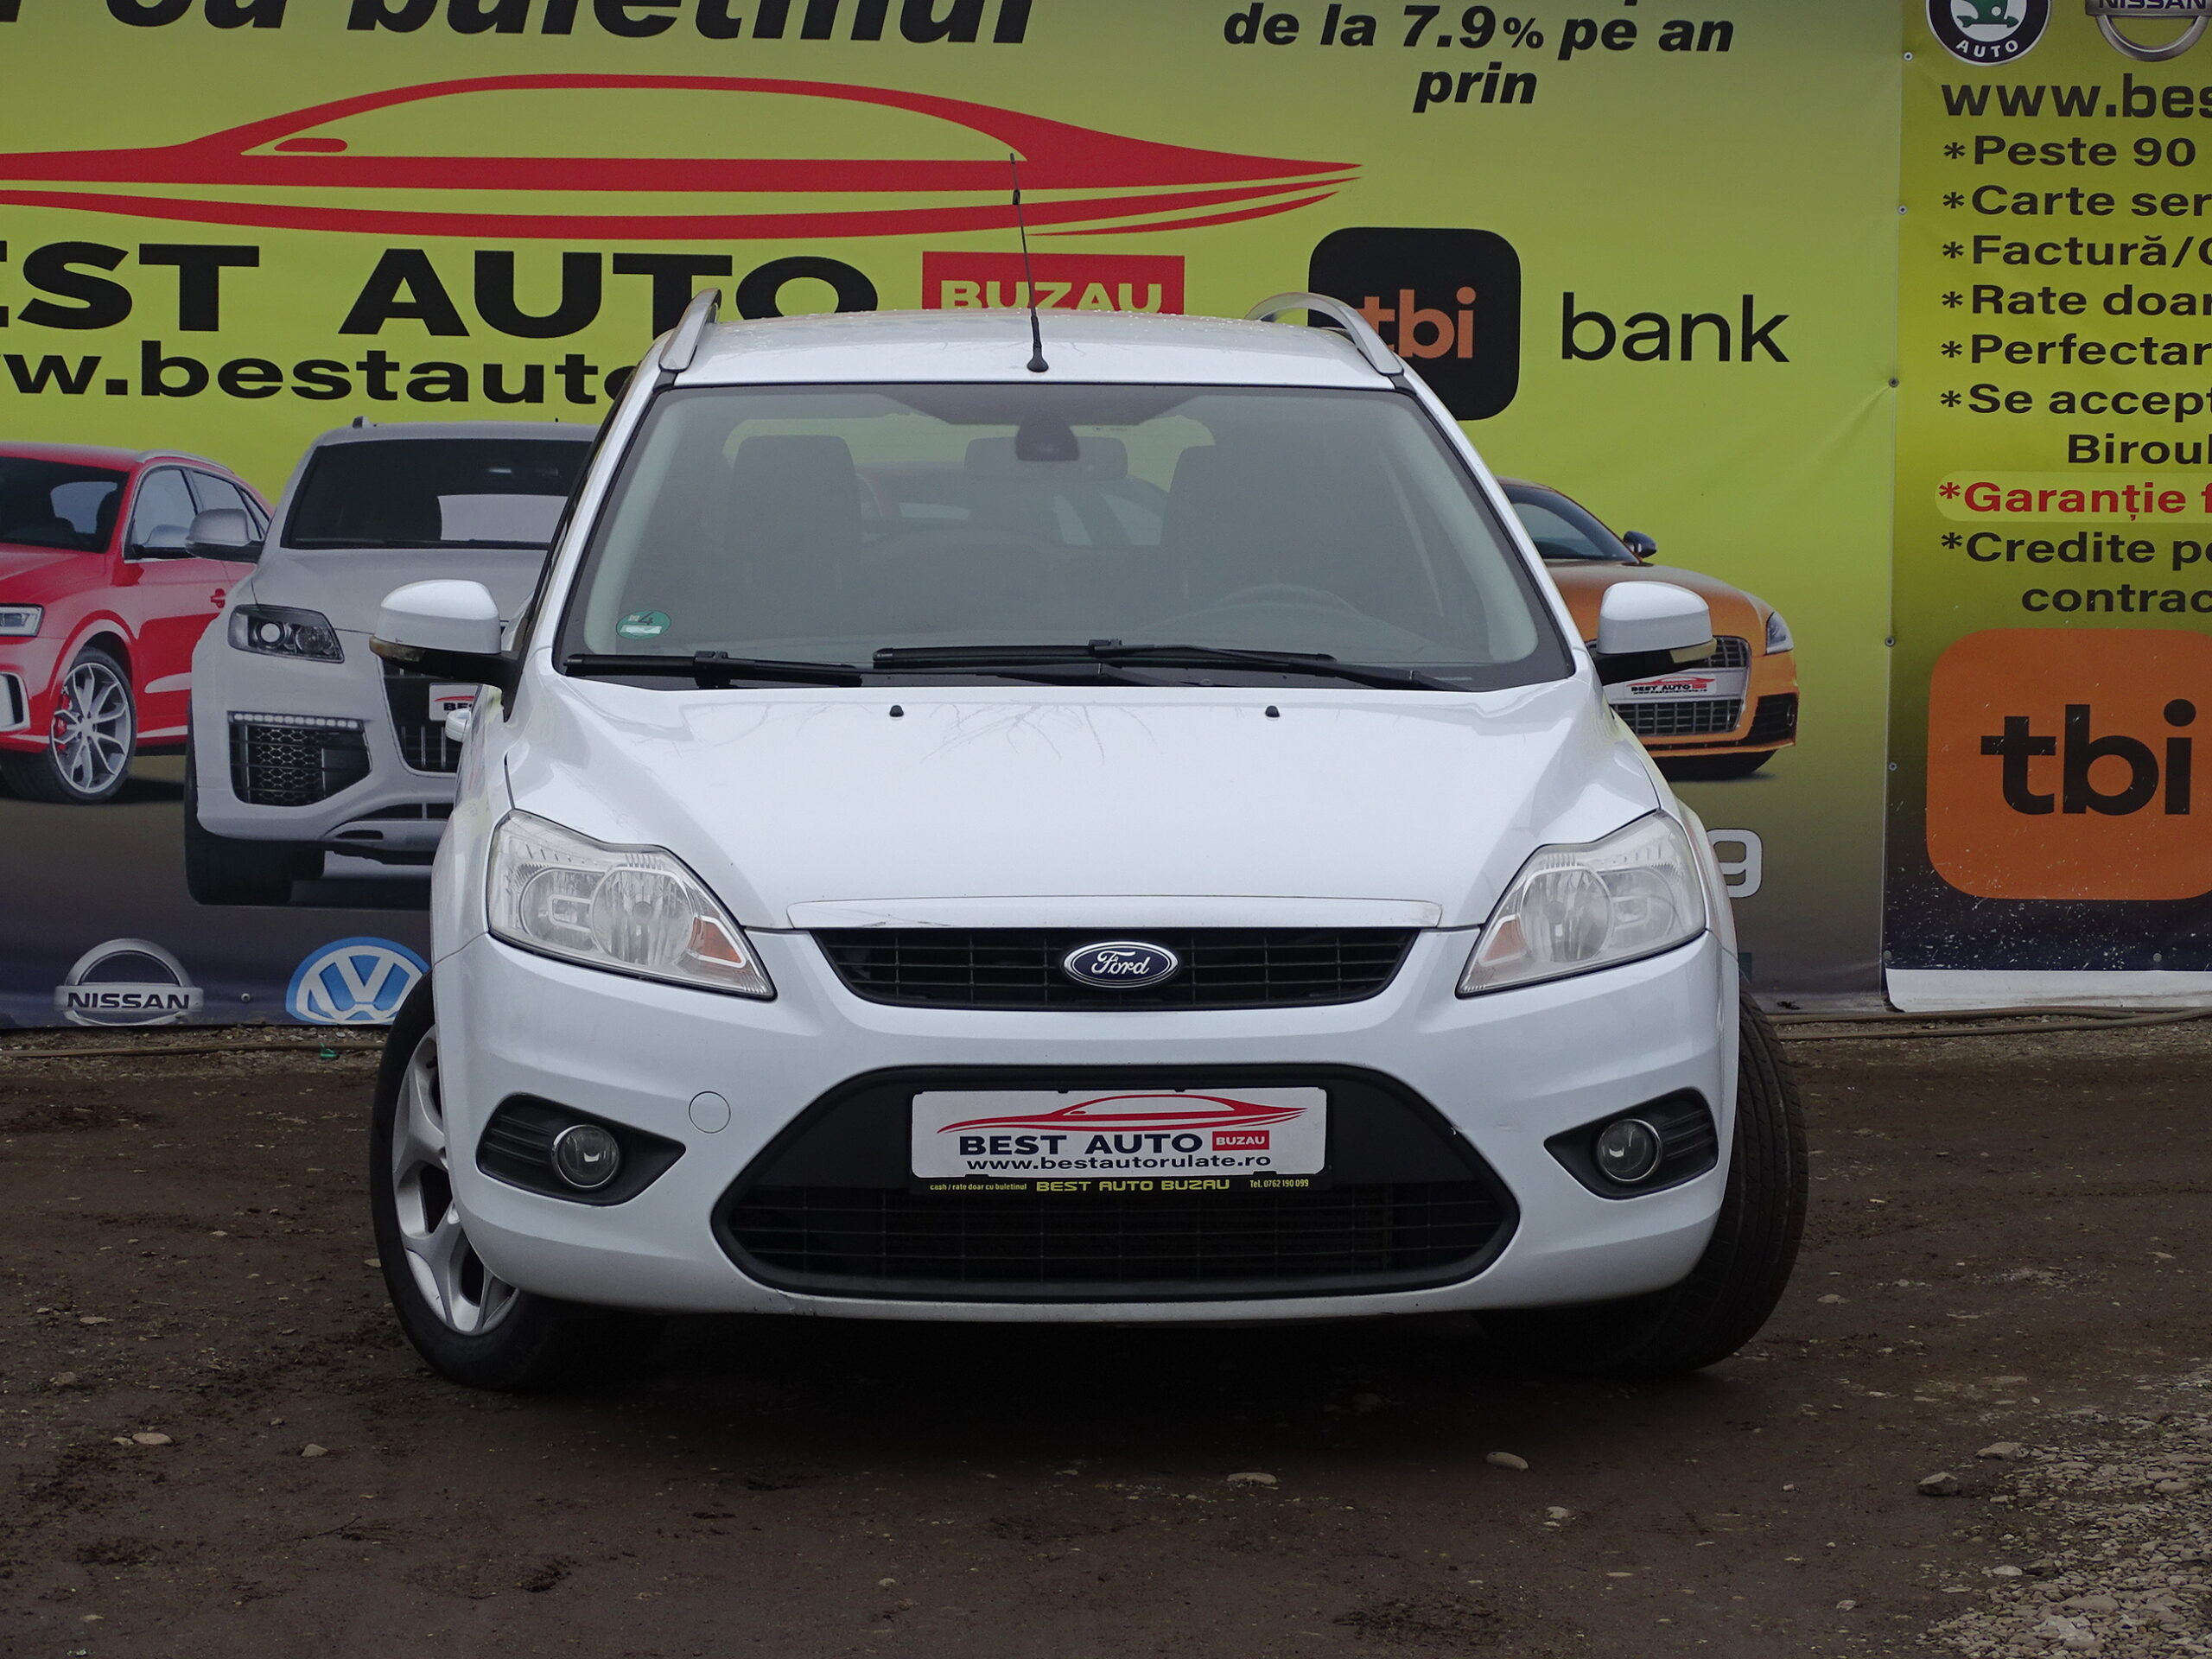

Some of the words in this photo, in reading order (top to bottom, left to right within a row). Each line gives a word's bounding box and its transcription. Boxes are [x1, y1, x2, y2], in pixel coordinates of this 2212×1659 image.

[1224, 3, 1300, 46] de
[1320, 4, 1377, 47] la
[1558, 19, 1637, 61] pe
[1659, 20, 1734, 53] an
[1955, 40, 2019, 59] AUTO
[1413, 62, 1537, 113] prin
[2133, 137, 2196, 168] 90
[0, 240, 259, 332] ST
[338, 248, 879, 338] AUTO
[941, 279, 1161, 315] BUZAU
[1561, 291, 1790, 363] bank
[2172, 540, 2212, 572] p
[1980, 698, 2196, 816] tbi
[1090, 950, 1151, 975] Ford
[67, 991, 190, 1010] NISSAN
[959, 1135, 1067, 1155] BEST
[1084, 1133, 1203, 1154] AUTO
[1216, 1136, 1266, 1146] BUZAU
[966, 1154, 1272, 1171] www.bestautorulate.ro
[952, 1182, 968, 1191] rate
[968, 1181, 985, 1191] doar
[995, 1181, 1027, 1191] buletinul
[1037, 1181, 1091, 1192] BEST
[1099, 1180, 1154, 1192] AUTO
[1161, 1179, 1230, 1191] BUZAU
[1249, 1179, 1263, 1188] Tel.
[1263, 1179, 1281, 1188] 0762
[1295, 1179, 1310, 1188] 099
